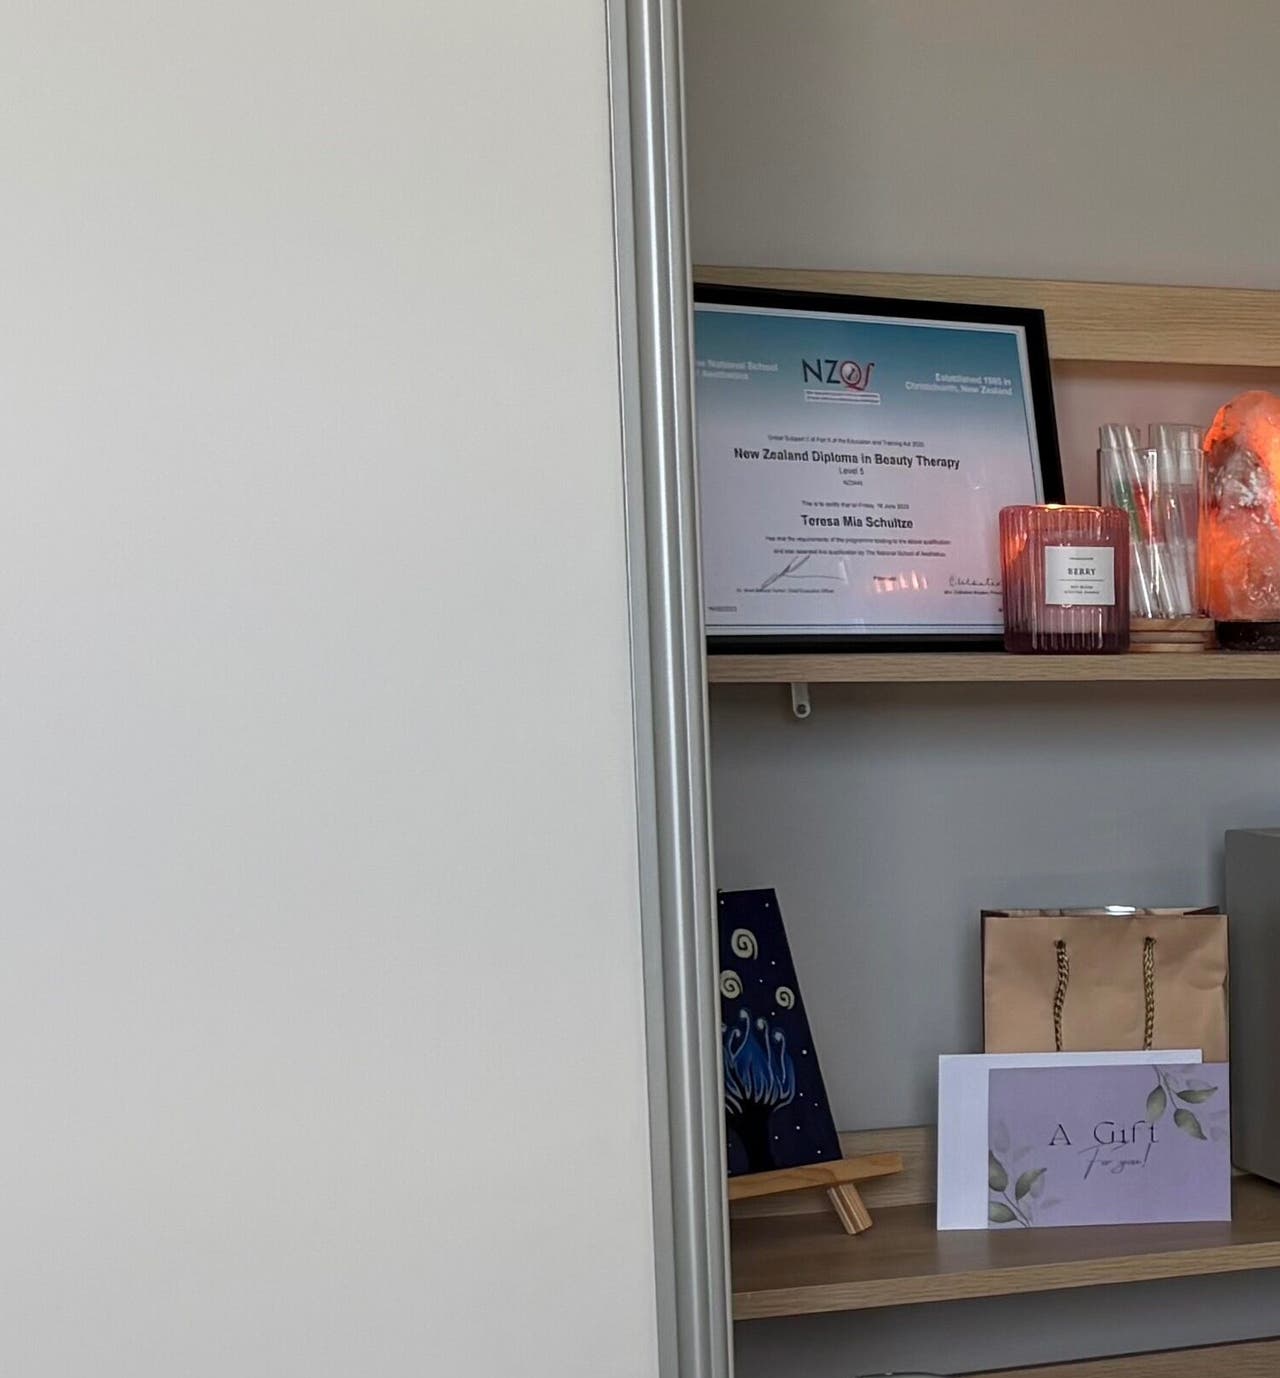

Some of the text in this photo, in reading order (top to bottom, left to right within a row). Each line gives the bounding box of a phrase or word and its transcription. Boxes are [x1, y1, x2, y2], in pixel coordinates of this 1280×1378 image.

[734, 447, 961, 470] New Zealand Diploma in Beauty Therapy
[838, 467, 859, 476] Level
[800, 514, 914, 529] Teresa Mia Schultze
[1048, 1119, 1160, 1146] A Gift
